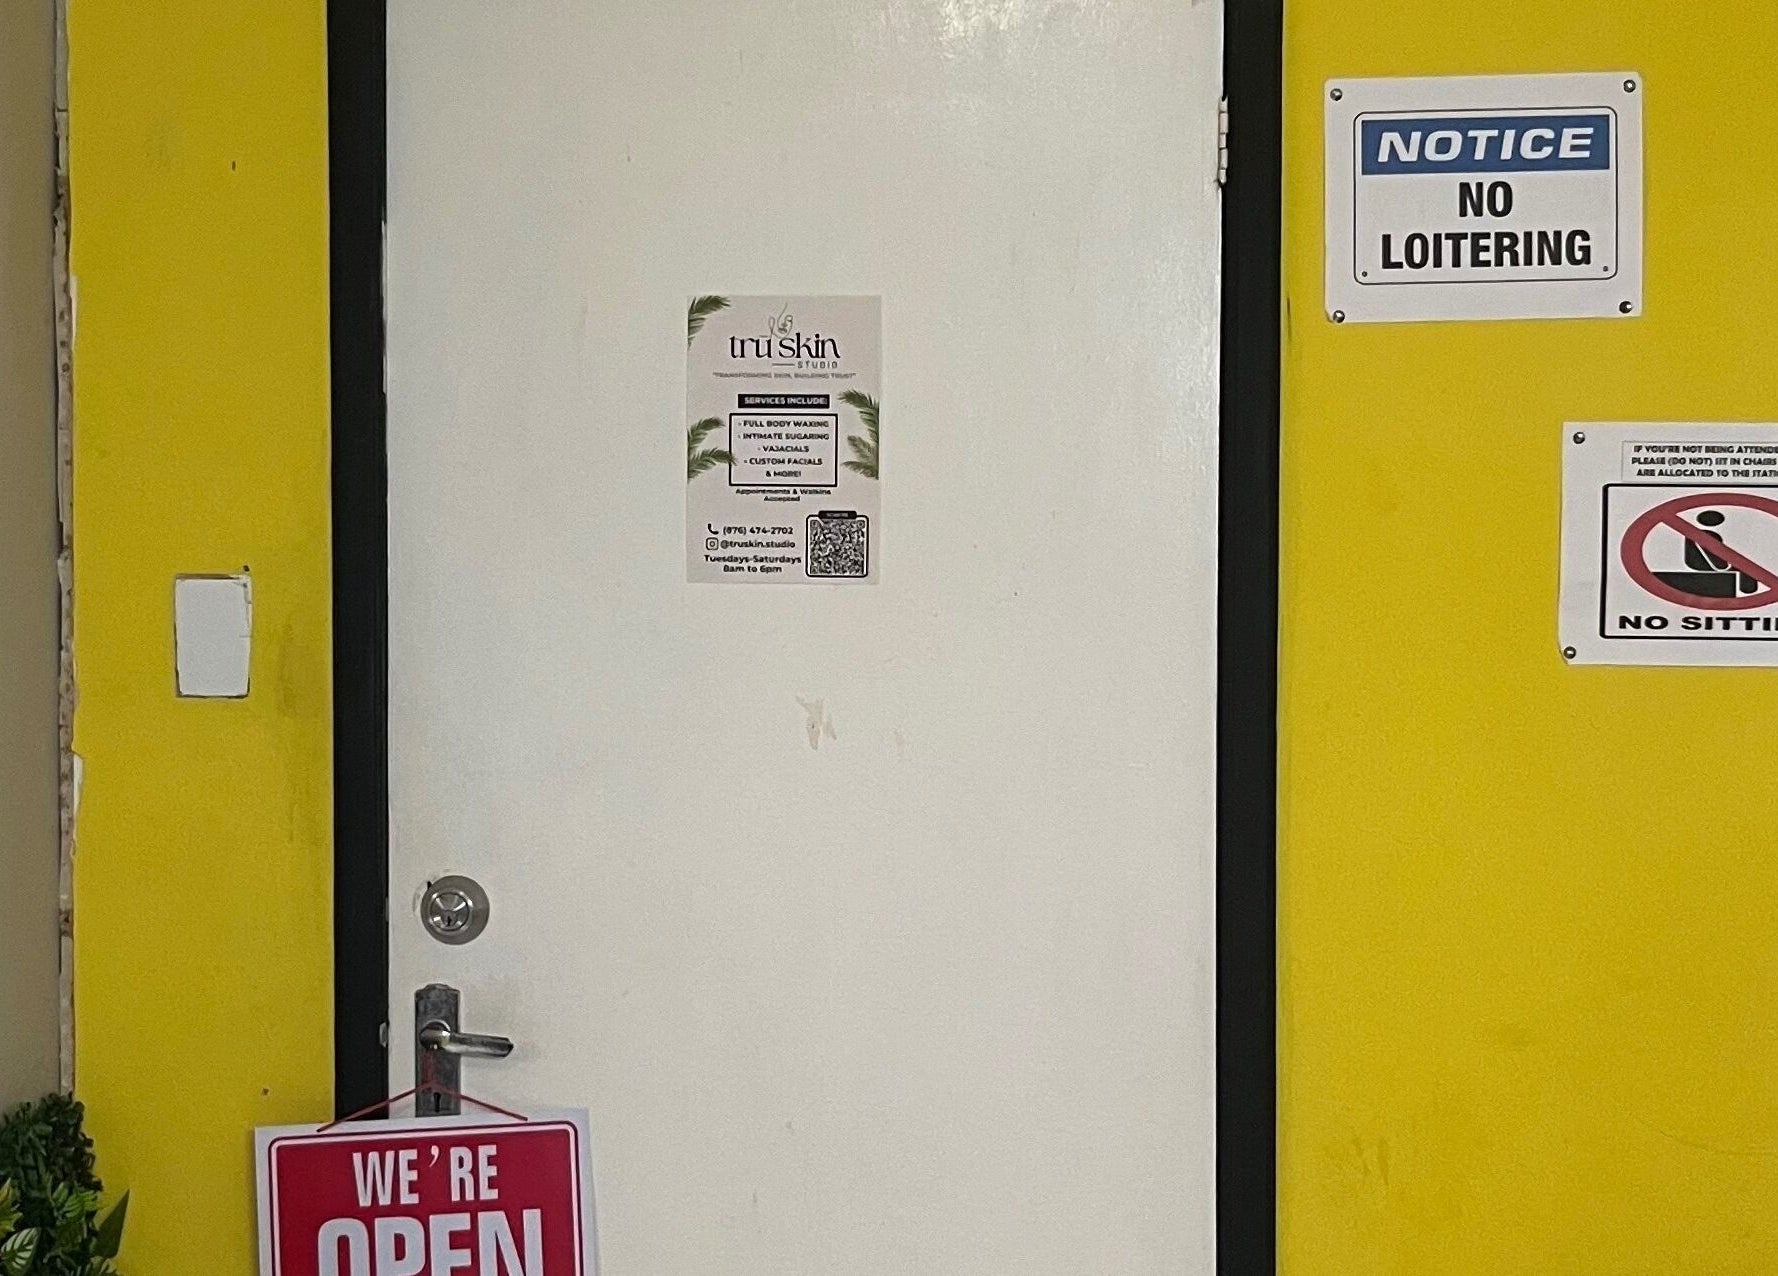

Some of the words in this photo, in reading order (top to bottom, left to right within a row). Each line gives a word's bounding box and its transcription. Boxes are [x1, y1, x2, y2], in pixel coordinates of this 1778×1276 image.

[1377, 127, 1594, 163] NOTICE
[1458, 181, 1513, 218] NO
[1381, 229, 1591, 270] LOITERING
[779, 332, 841, 358] skin
[797, 360, 838, 369] STUDIO
[744, 396, 786, 405] SERVICES
[743, 420, 765, 428] FULL
[766, 420, 791, 428] BODY
[793, 420, 829, 428] WAXING
[743, 432, 783, 440] INTIMATE
[785, 432, 830, 440] SUGARING
[762, 445, 810, 453] VAJACIALS
[1633, 445, 1643, 453] IF
[1645, 445, 1680, 453] YOU'RE
[1682, 445, 1703, 454] NOT
[1705, 445, 1734, 454] BEING
[749, 457, 786, 465] CUSTOM
[787, 457, 823, 466] FACIALS
[1631, 456, 1666, 465] PLEASE
[1667, 457, 1686, 466] (DO
[1688, 457, 1713, 466] NOT)
[1715, 457, 1728, 465] SIT
[1729, 457, 1740, 465] IN
[1743, 457, 1777, 466] CHAIRS
[765, 470, 772, 478] &
[773, 470, 802, 478] MORE!
[1636, 468, 1656, 477] ARE
[1657, 468, 1714, 477] ALLOCATED
[1716, 469, 1729, 477] TO
[1731, 469, 1750, 478] THE
[735, 488, 791, 496] Appointments
[722, 526, 747, 536] (876)
[749, 526, 794, 535] 474-2702
[720, 540, 796, 549] @truskin.studio
[703, 554, 802, 564] Tuesdays-Saturdays
[723, 564, 745, 573] 8am
[747, 565, 758, 573] to
[759, 565, 783, 574] 6pm
[1619, 615, 1669, 630] NO
[352, 1144, 499, 1207] WE'RE
[317, 1208, 544, 1276] OPEN
